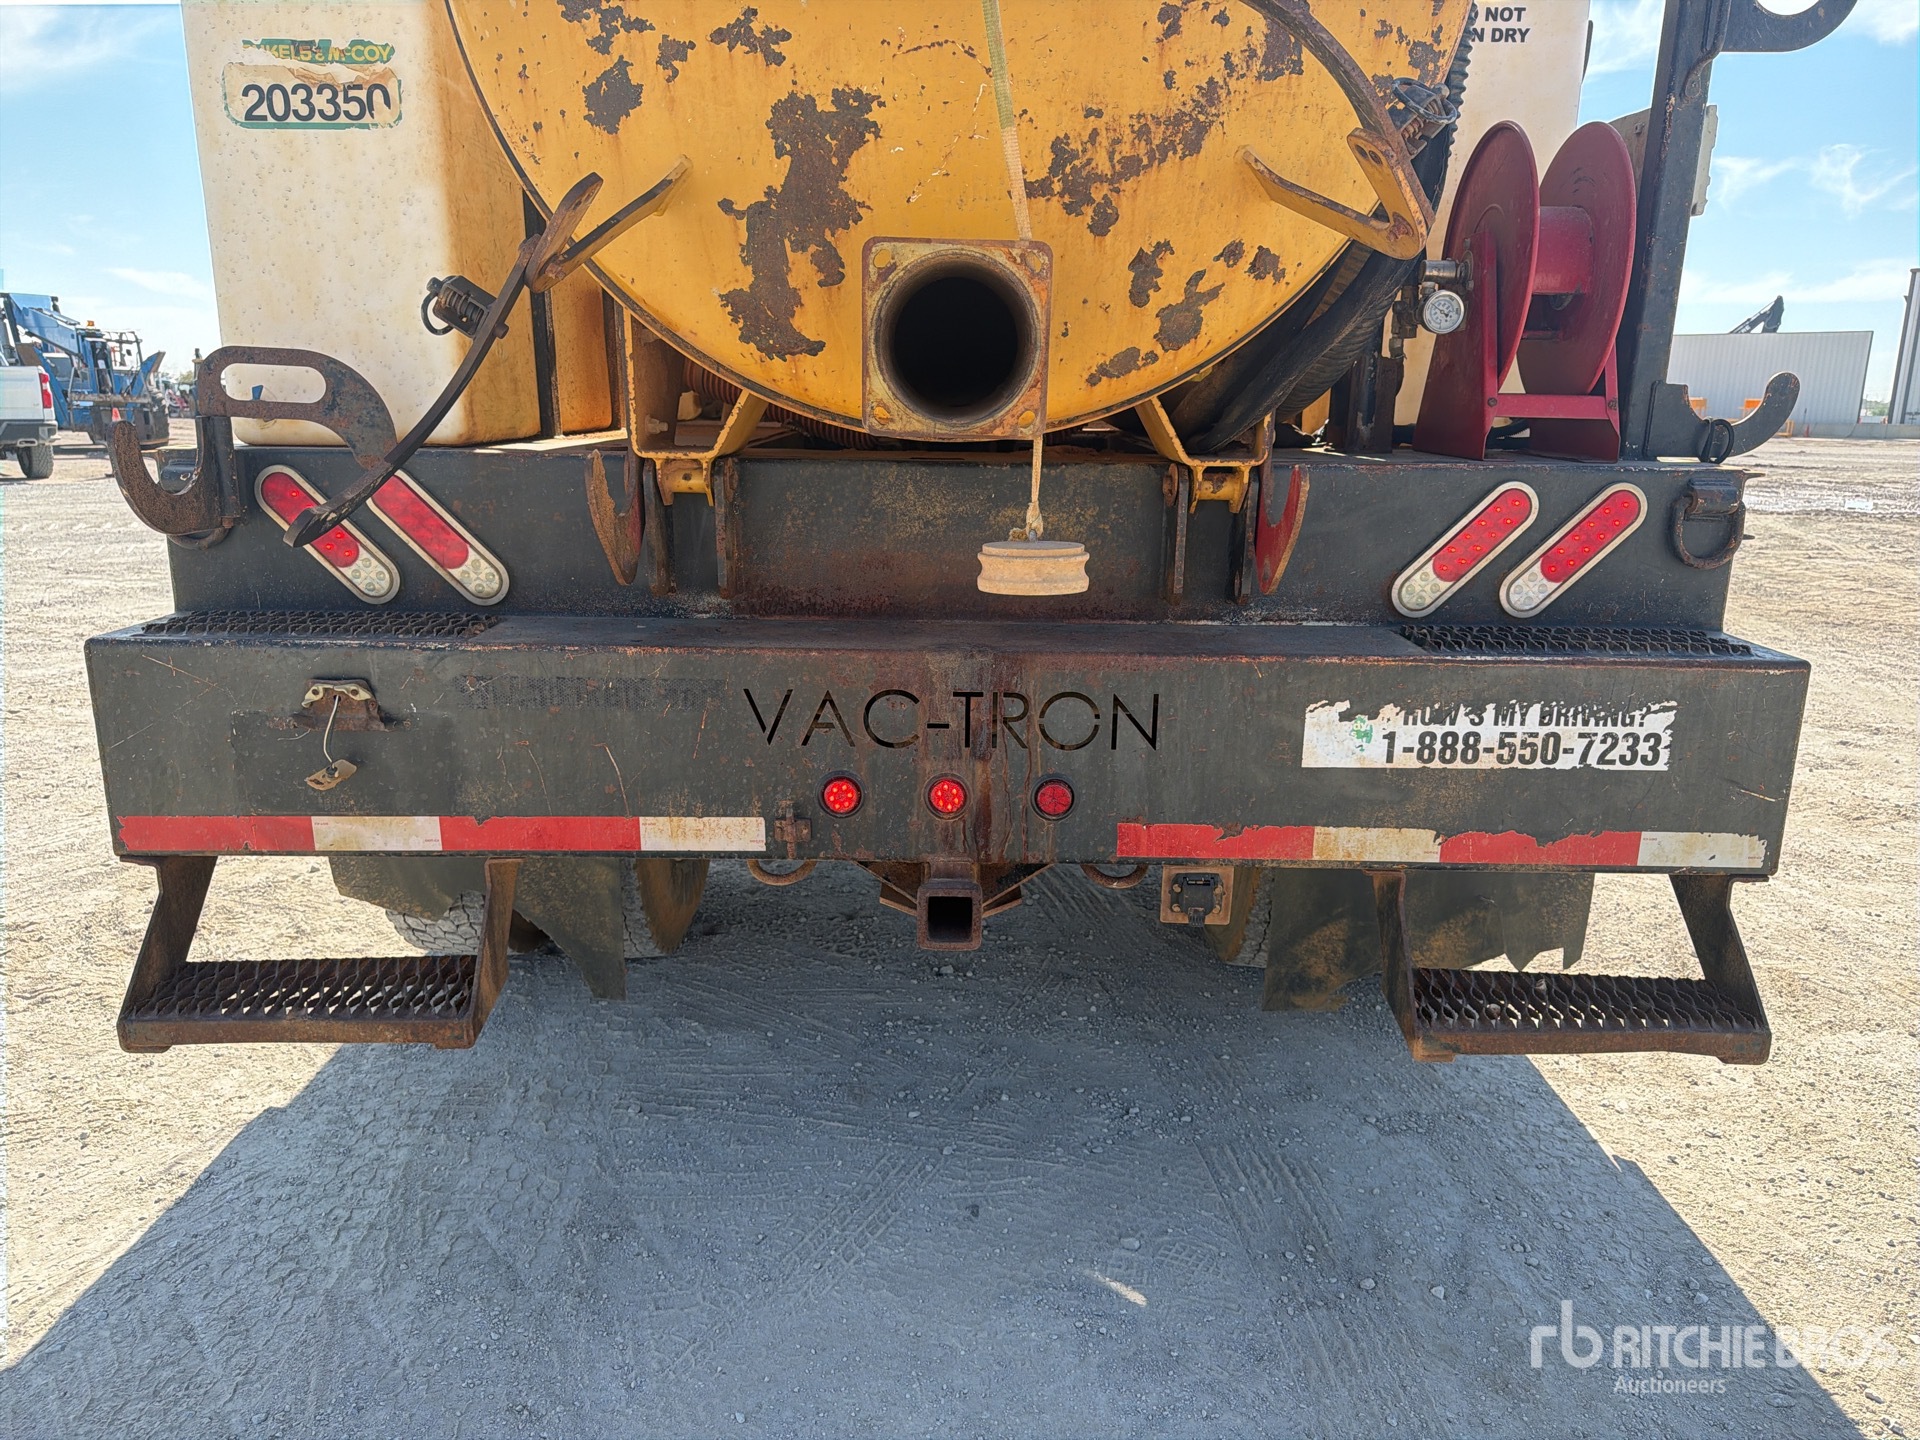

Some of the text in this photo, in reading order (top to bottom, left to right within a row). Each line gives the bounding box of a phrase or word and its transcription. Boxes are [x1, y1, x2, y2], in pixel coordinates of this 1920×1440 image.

[1485, 7, 1526, 22] NOT
[1491, 28, 1530, 42] DRY
[242, 83, 391, 121] 203350
[743, 688, 1159, 751] VAC-TRON
[1382, 731, 1662, 766] 1-888-550-7233
